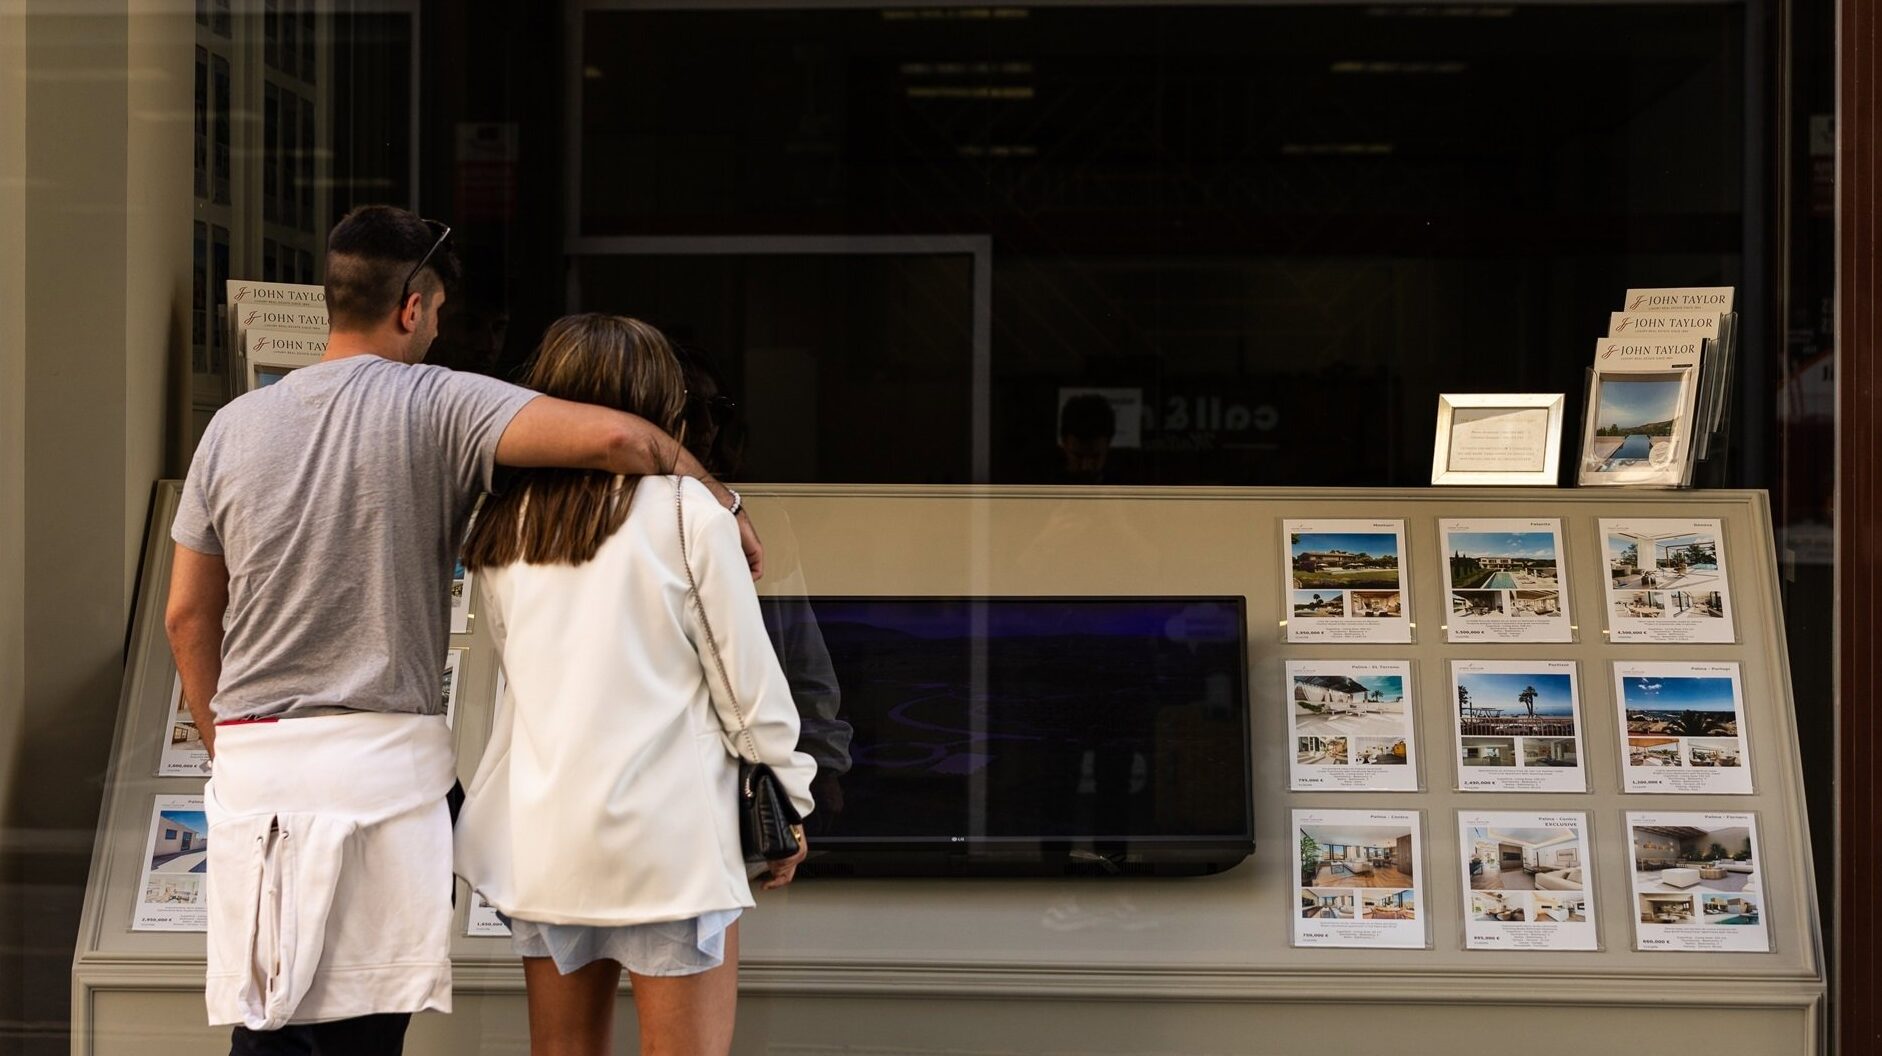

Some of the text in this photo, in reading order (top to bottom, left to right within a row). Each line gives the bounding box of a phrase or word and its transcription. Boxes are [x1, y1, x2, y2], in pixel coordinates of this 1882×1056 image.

[254, 288, 326, 302] JOHN TAYLO
[1648, 295, 1726, 306] JOHN TAYLOR
[263, 312, 329, 326] JOHN TAYL
[1635, 318, 1713, 328] JOHN TAYLOR
[272, 339, 328, 351] JOHN TAY
[1620, 344, 1695, 356] JOHN TAYLOR
